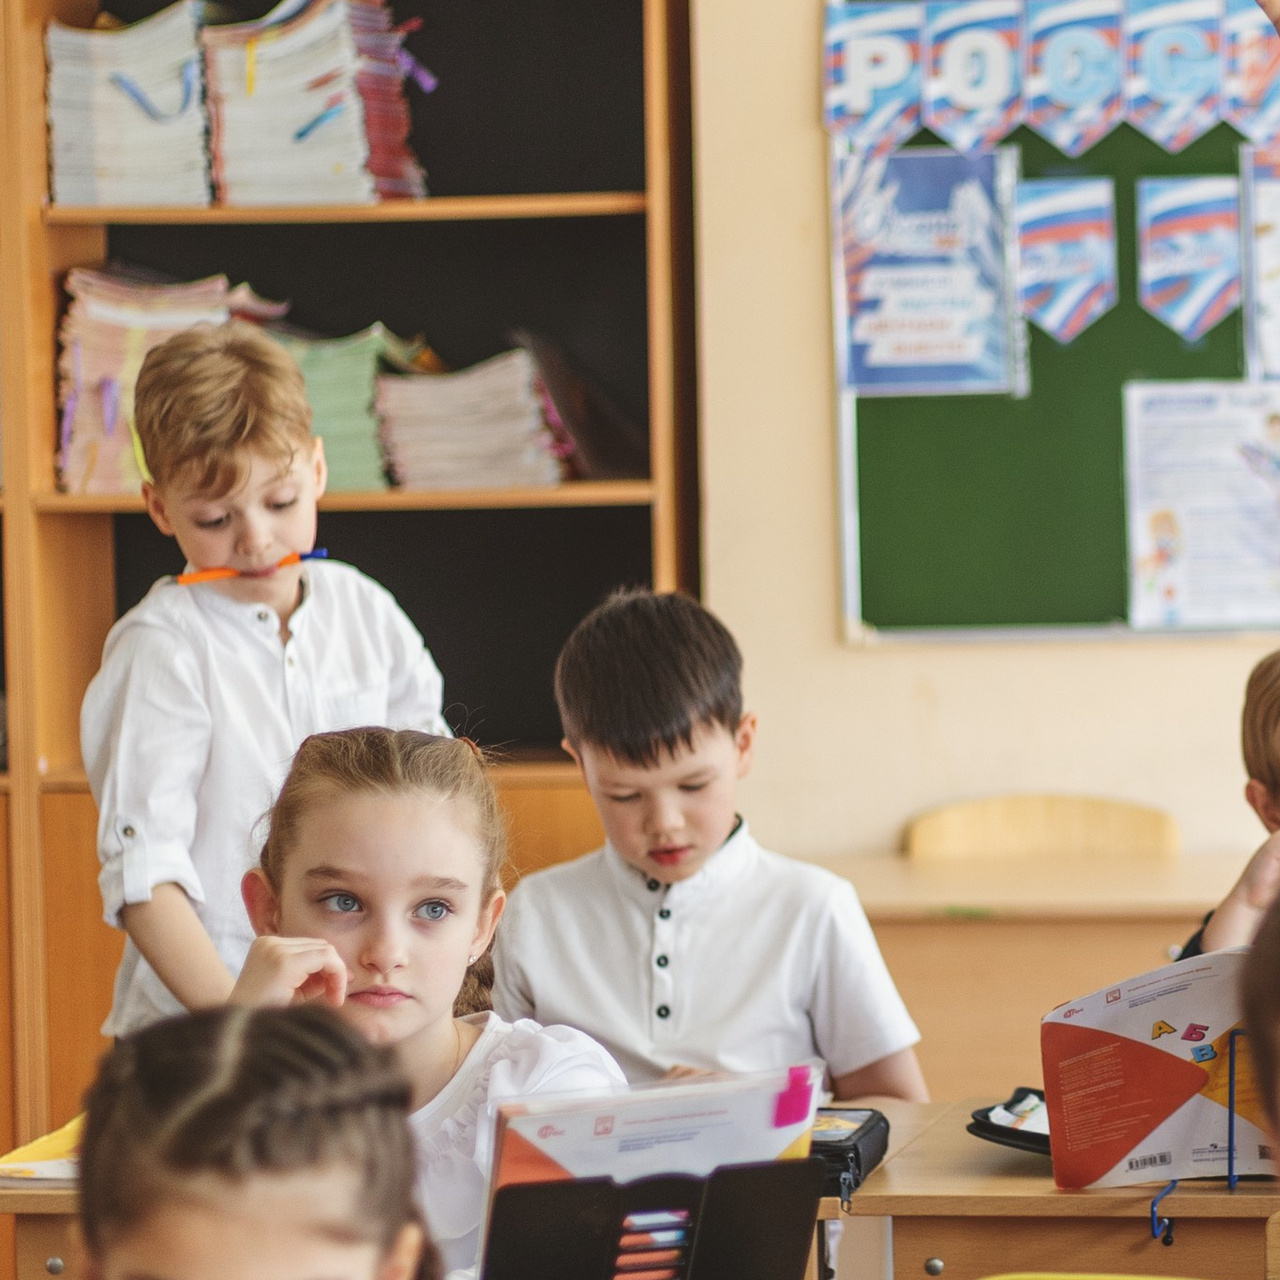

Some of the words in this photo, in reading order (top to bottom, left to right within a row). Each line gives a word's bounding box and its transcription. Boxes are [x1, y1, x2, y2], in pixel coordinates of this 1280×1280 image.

[1151, 1020, 1177, 1040] А
[1181, 1023, 1209, 1041] Б
[1191, 1044, 1217, 1063] В
